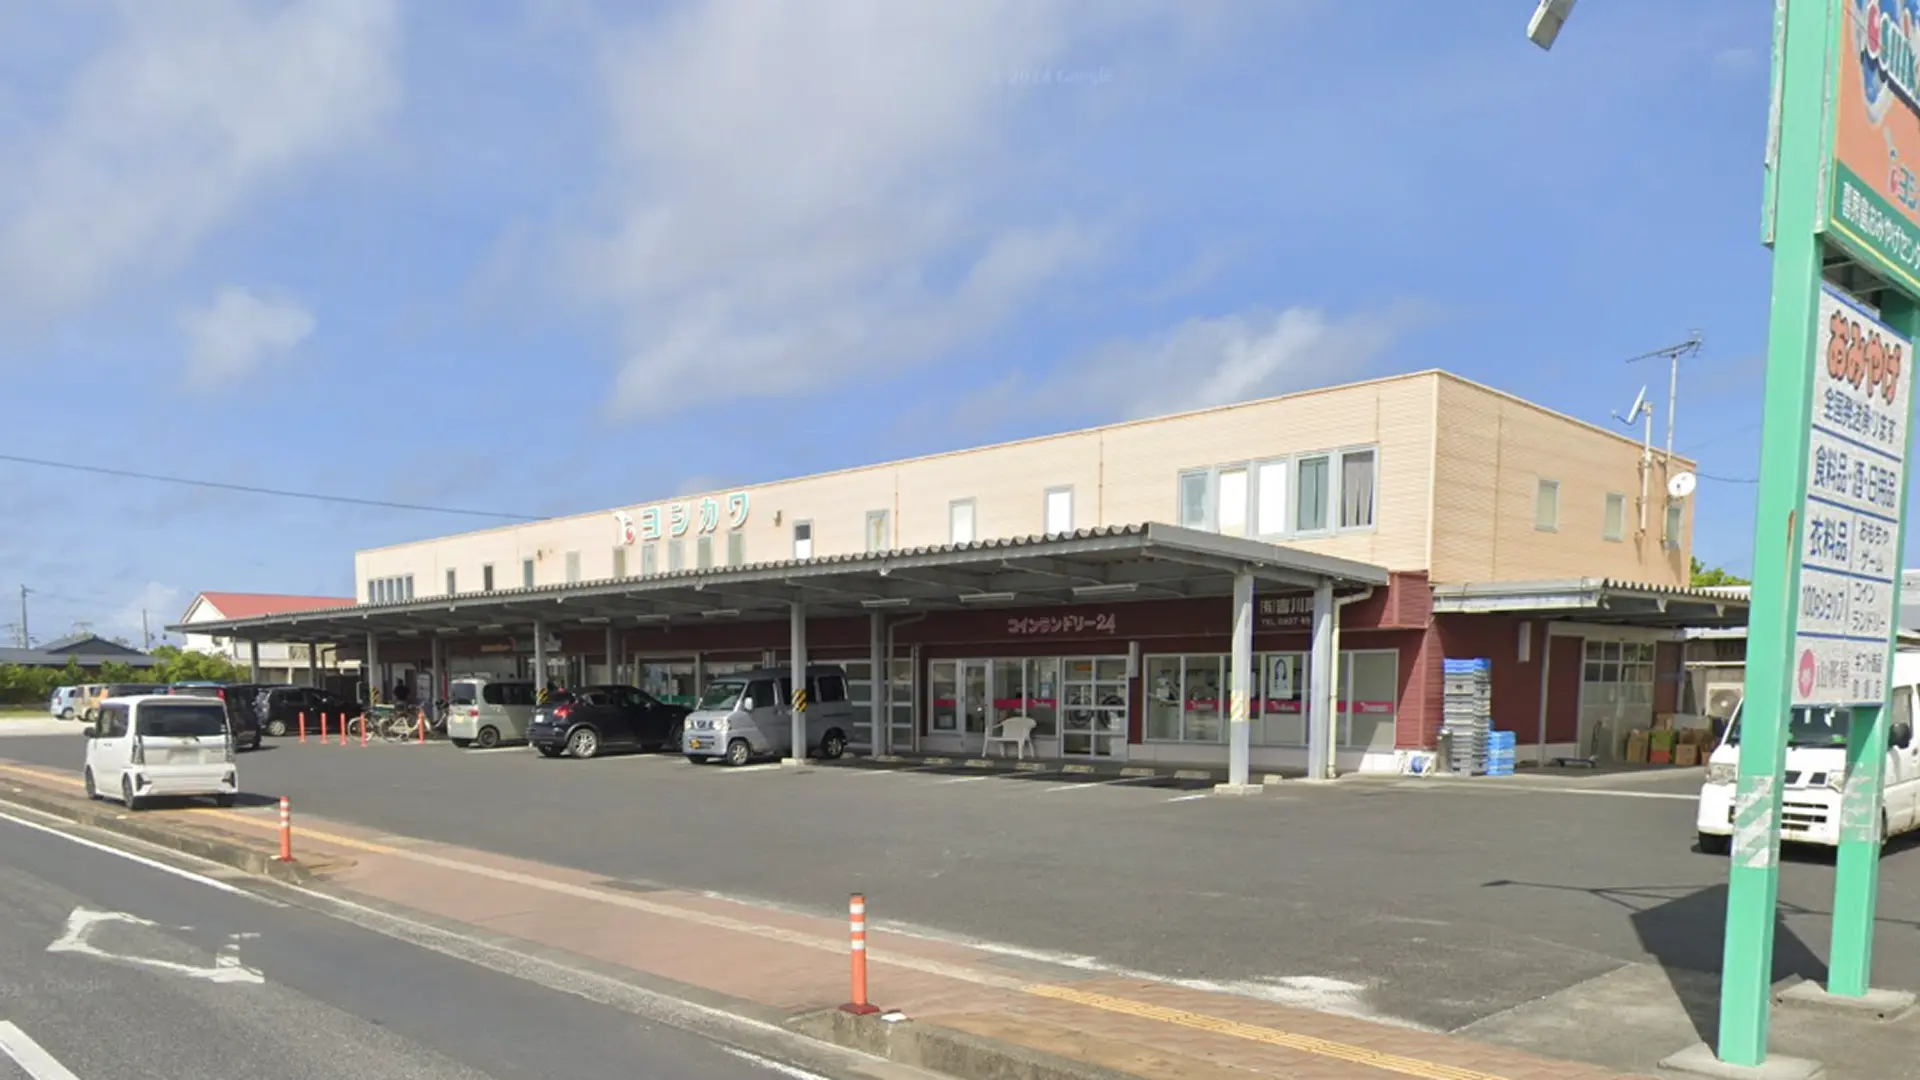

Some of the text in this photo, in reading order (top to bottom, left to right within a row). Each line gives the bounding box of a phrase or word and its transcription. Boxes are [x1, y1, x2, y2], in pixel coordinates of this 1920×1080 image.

[1827, 309, 1901, 406] おみやげ
[643, 491, 749, 541] ヨシカワ
[1810, 515, 1847, 562] 衣料品
[1859, 521, 1890, 545] おもちゃ
[1860, 550, 1885, 574] ゲーム
[1854, 582, 1876, 604] コイン
[1007, 613, 1117, 634] コインランドリー24
[1852, 610, 1886, 632] ランドリー
